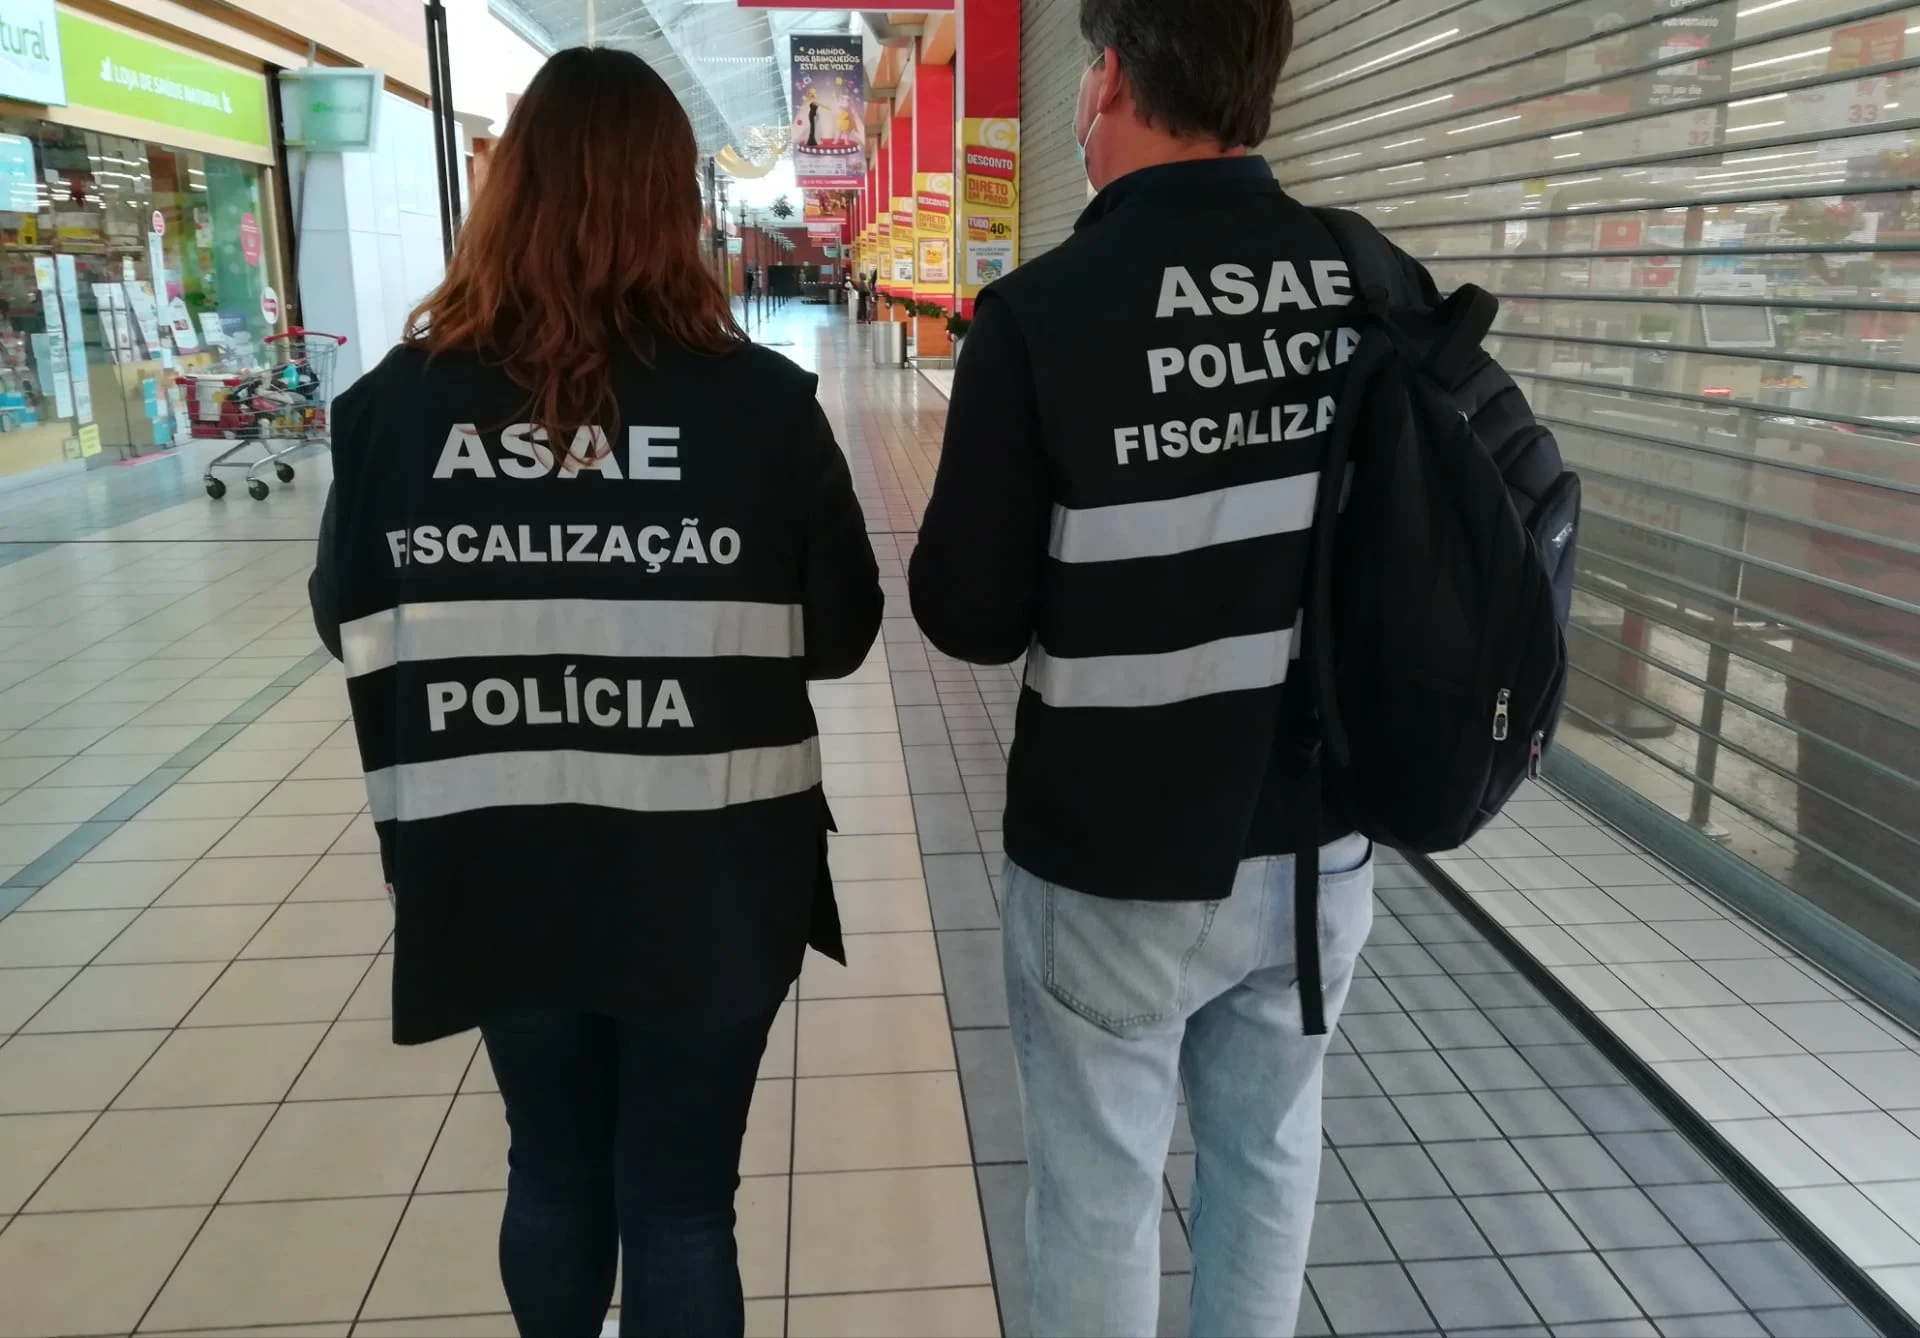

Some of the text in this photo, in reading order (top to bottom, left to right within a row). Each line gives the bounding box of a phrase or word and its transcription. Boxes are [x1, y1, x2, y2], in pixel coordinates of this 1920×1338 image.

[794, 55, 860, 63] DOS BRINQUEDOS
[1848, 103, 1877, 123] 33
[967, 153, 1013, 170] DESCONTO
[968, 178, 1009, 195] DIRETO
[1155, 260, 1354, 318] ASAE
[1146, 327, 1361, 394] POLÍCIA
[432, 423, 681, 480] ASAE
[386, 517, 741, 573] FISCALIZAÇÃO
[426, 665, 694, 731] POLÍCIA
